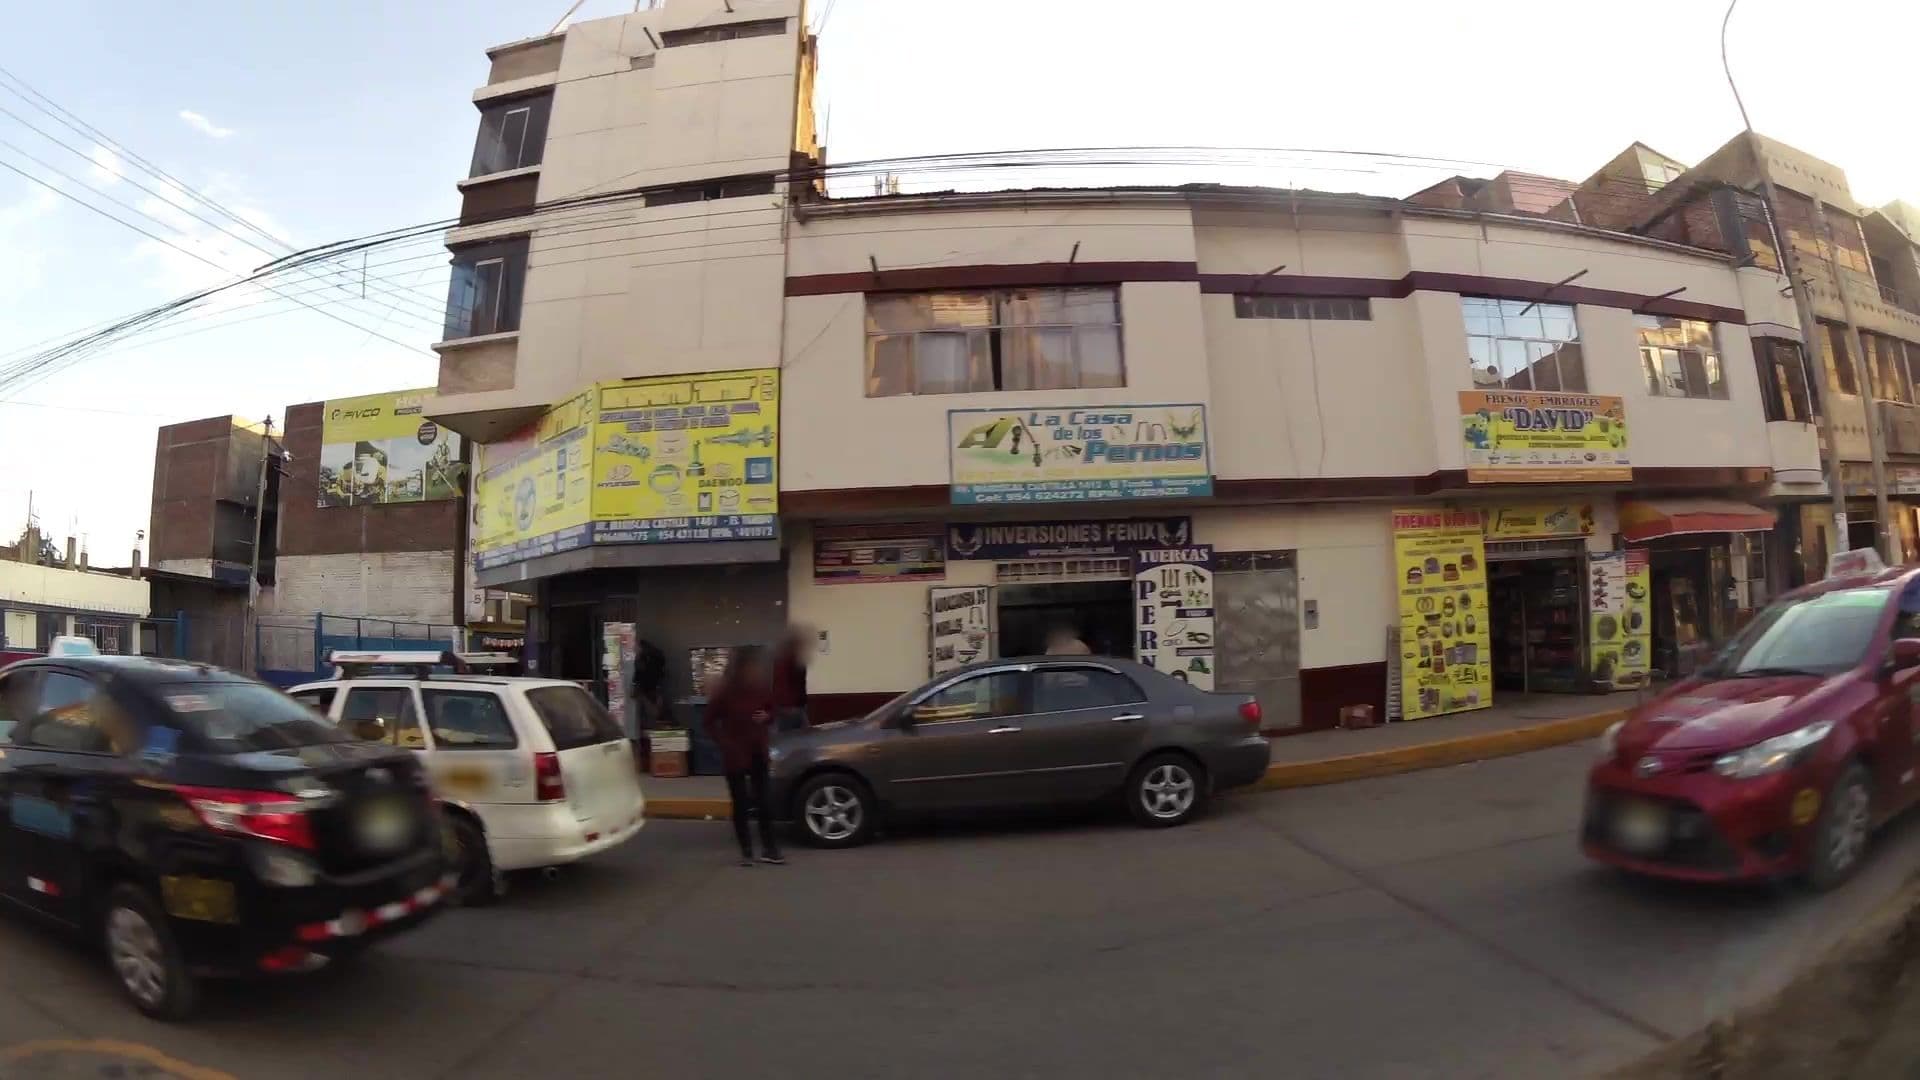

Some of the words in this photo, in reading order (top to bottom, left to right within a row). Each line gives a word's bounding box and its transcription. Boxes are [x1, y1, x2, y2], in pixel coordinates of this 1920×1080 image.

[1485, 394, 1528, 405] FRENOS
[1539, 396, 1601, 407] EMBRAGUES
[1028, 412, 1061, 427] La
[1068, 411, 1133, 426] Casa
[1053, 427, 1073, 440] de
[1077, 426, 1103, 440] los
[1083, 440, 1204, 463] Pernos
[698, 478, 743, 488] DAEWOO
[985, 525, 1100, 545] INVERSIONES
[1106, 522, 1160, 542] FENIX
[1138, 549, 1209, 564] TUERCAS
